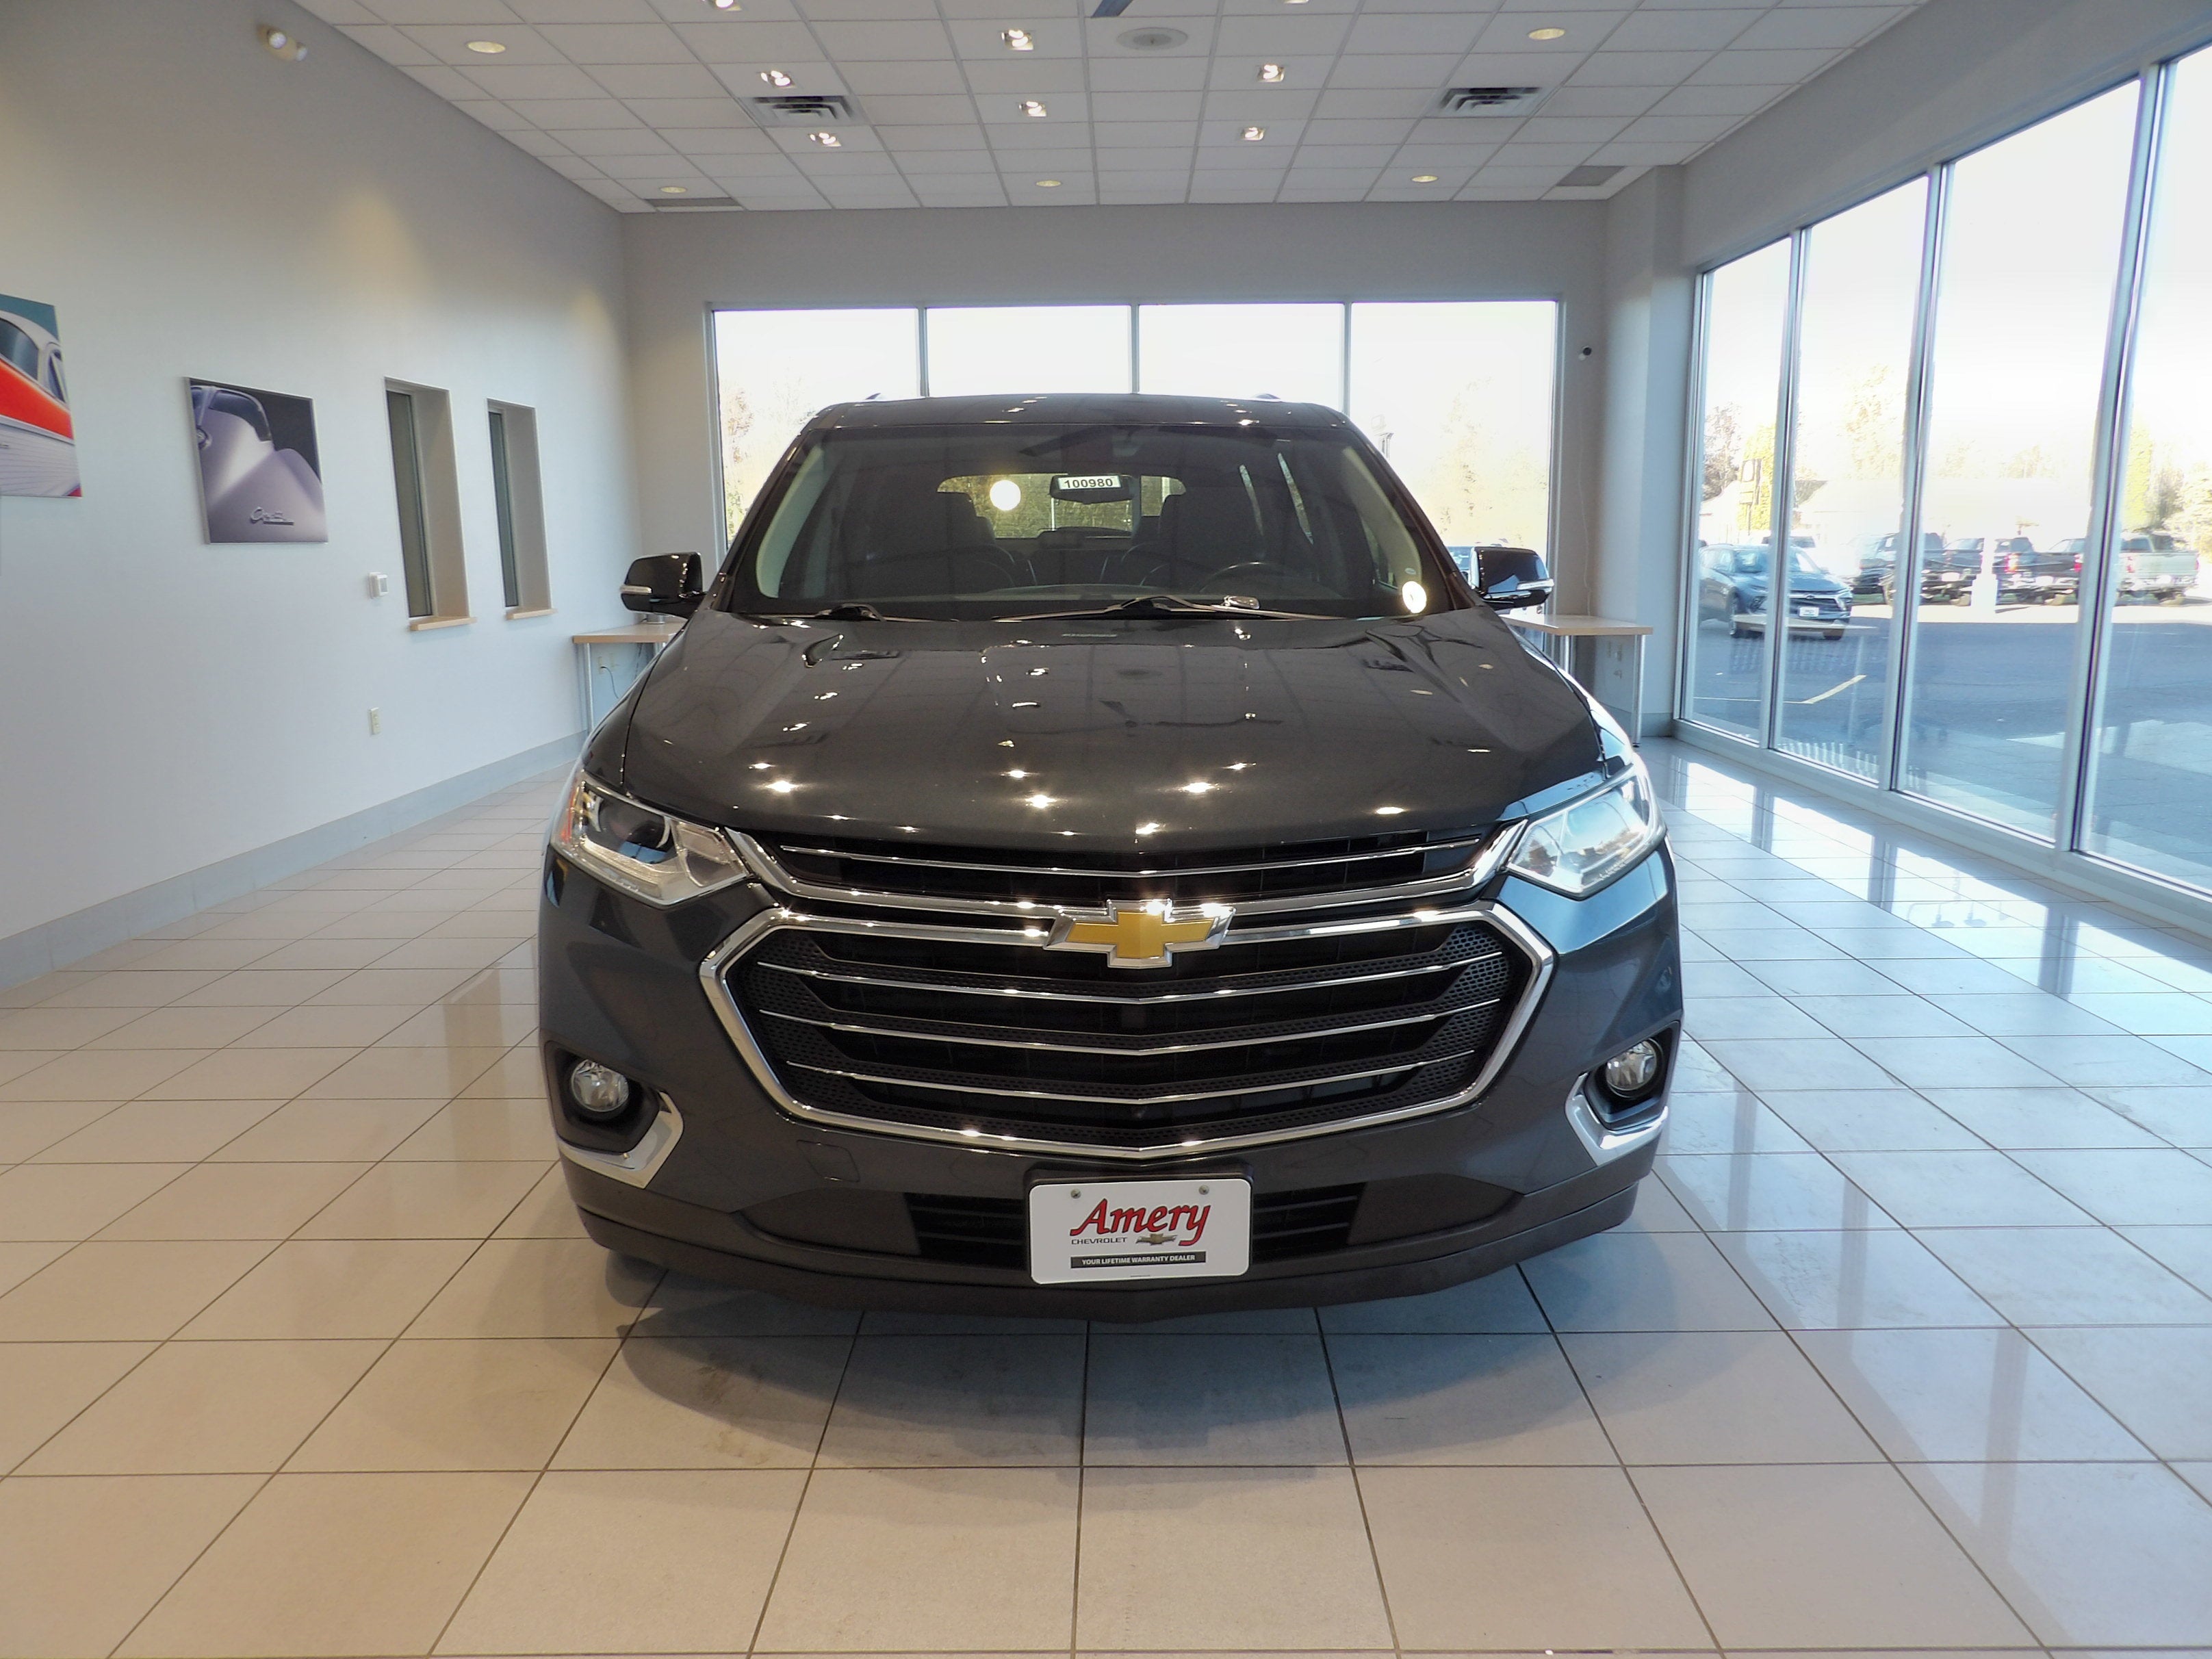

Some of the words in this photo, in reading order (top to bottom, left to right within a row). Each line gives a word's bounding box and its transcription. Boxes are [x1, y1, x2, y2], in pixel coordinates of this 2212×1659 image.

[1064, 478, 1113, 489] 100980
[1070, 1198, 1211, 1246] Amery
[1071, 1237, 1127, 1245] CHEVROLET
[1131, 1255, 1169, 1263] WARRANTY
